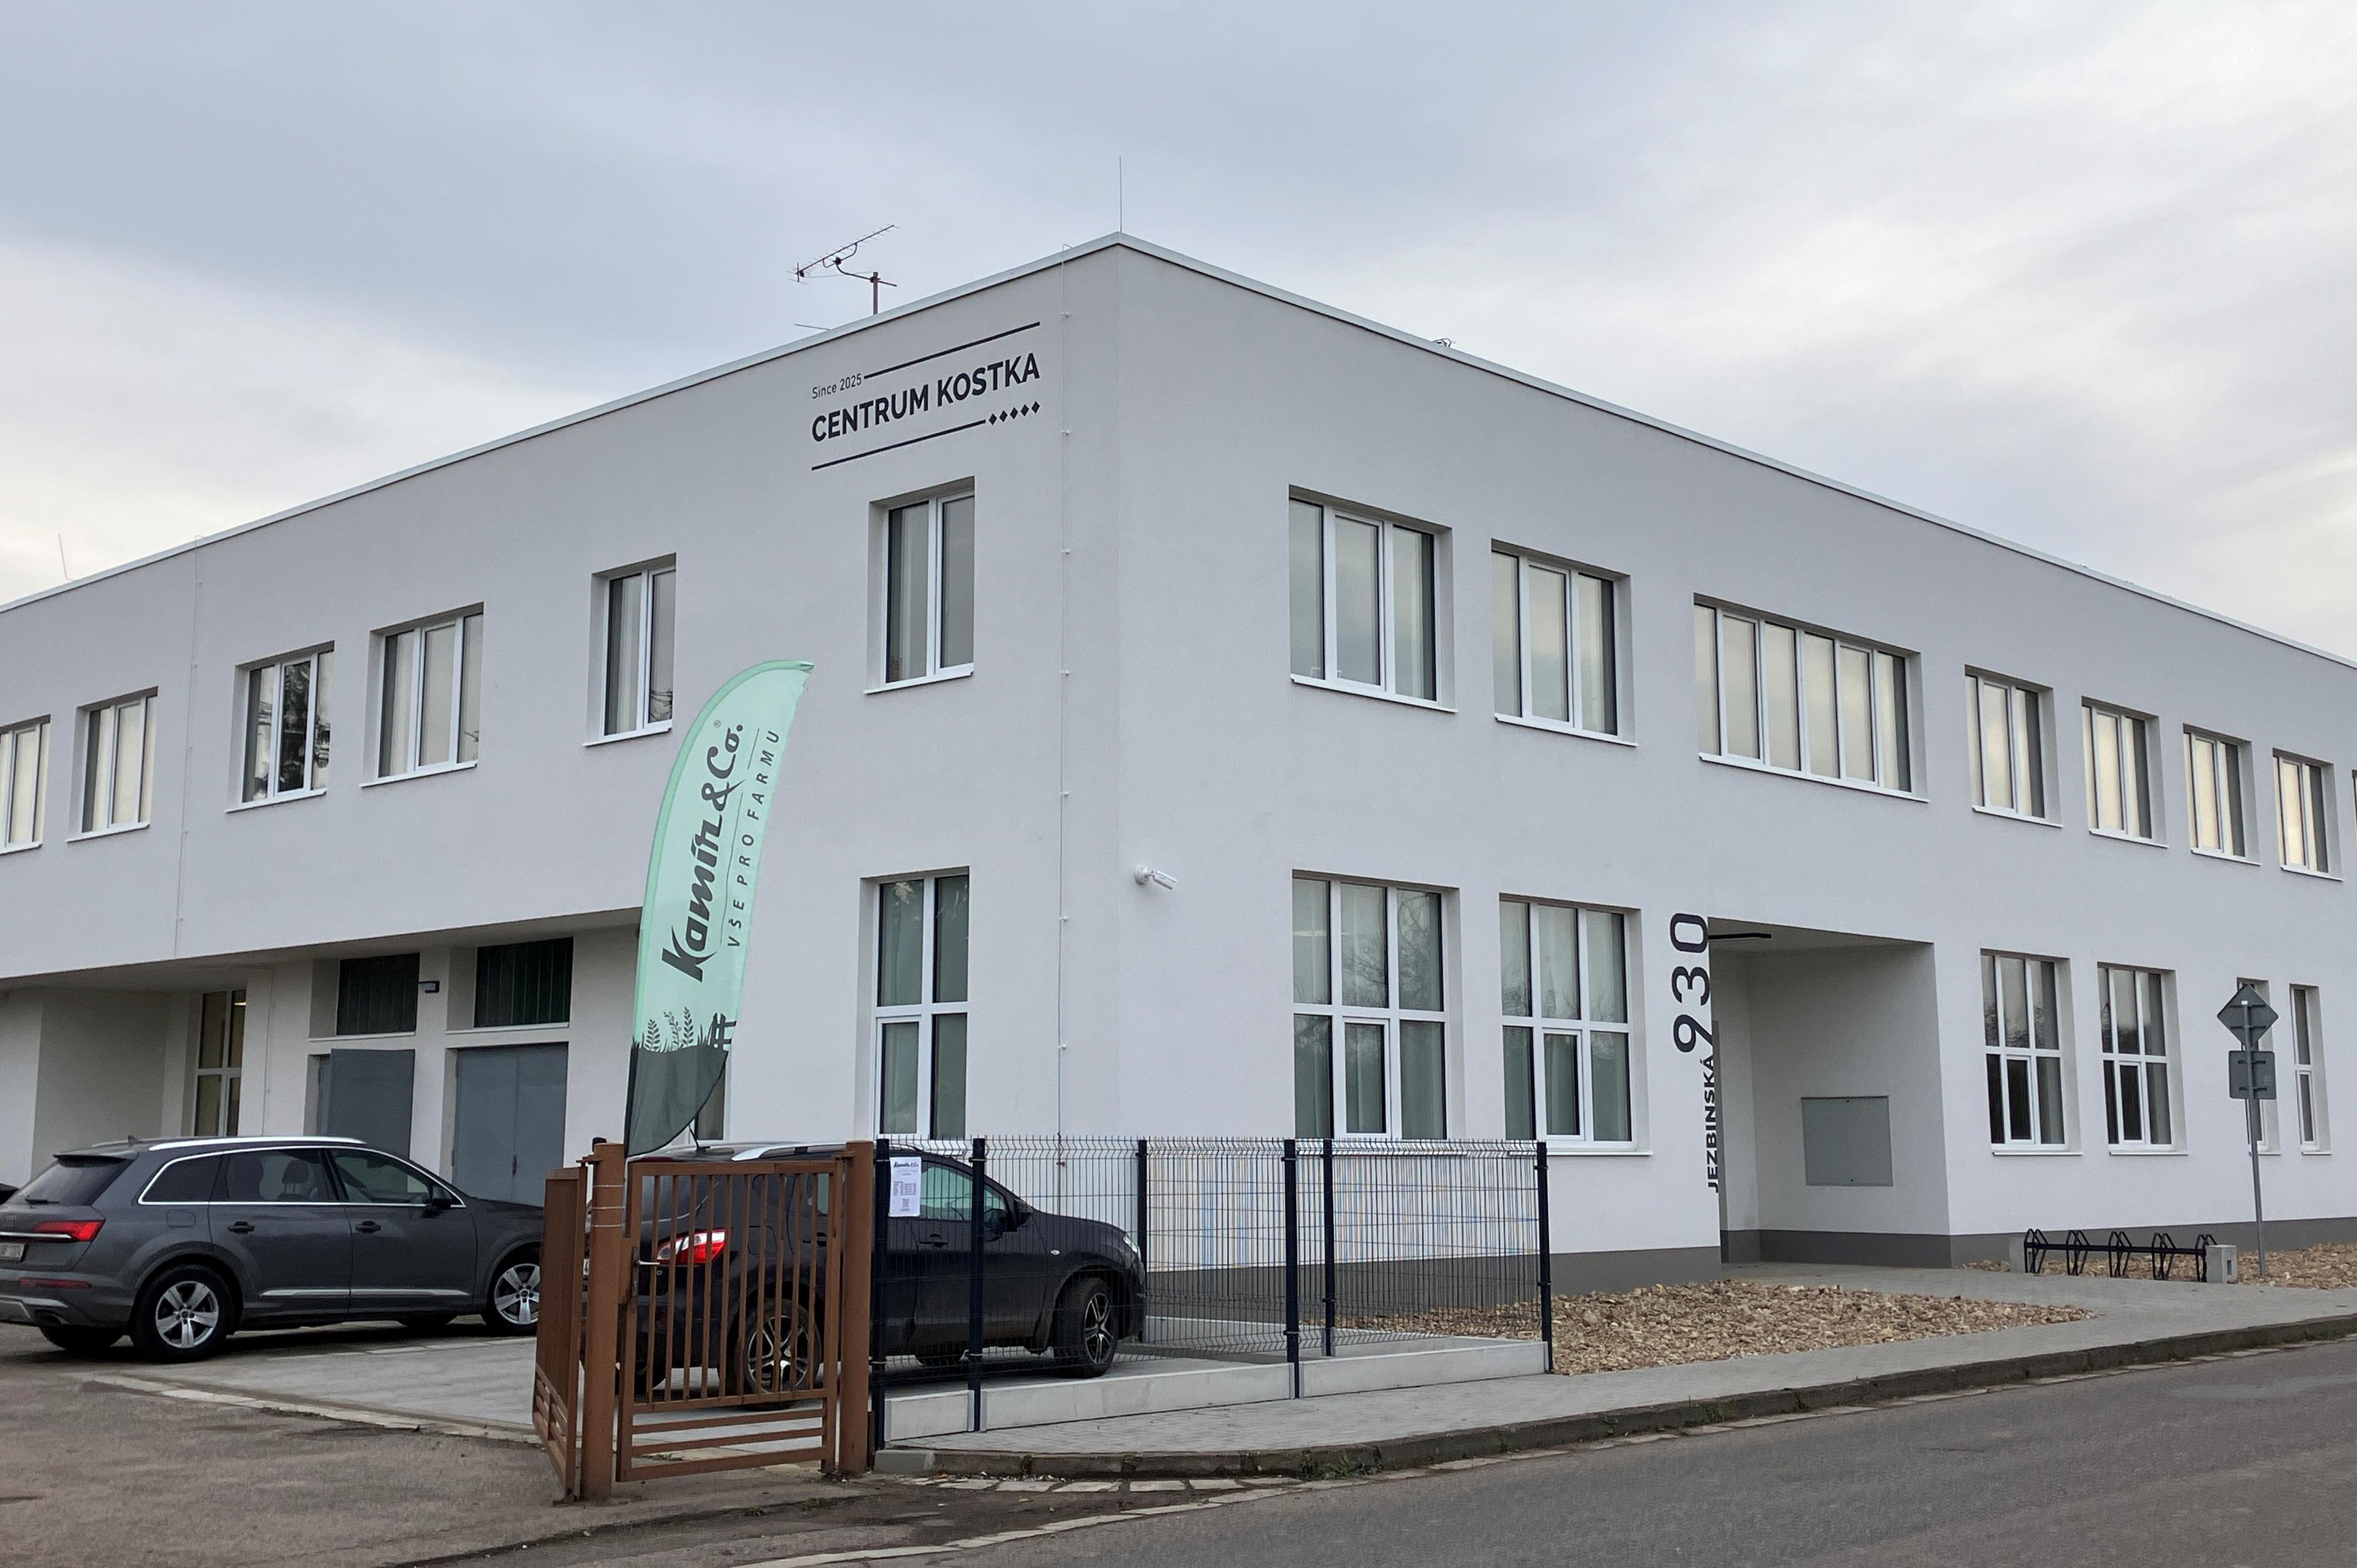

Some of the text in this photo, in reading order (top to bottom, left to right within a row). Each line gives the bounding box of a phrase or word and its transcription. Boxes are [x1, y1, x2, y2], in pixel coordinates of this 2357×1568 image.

[811, 372, 862, 400] Since 2025
[812, 352, 1041, 442] CENTRUM KOSTKA
[727, 730, 779, 947] VŠE PRO FARMU
[1669, 912, 1719, 1194] JEZBINSKÁ 930
